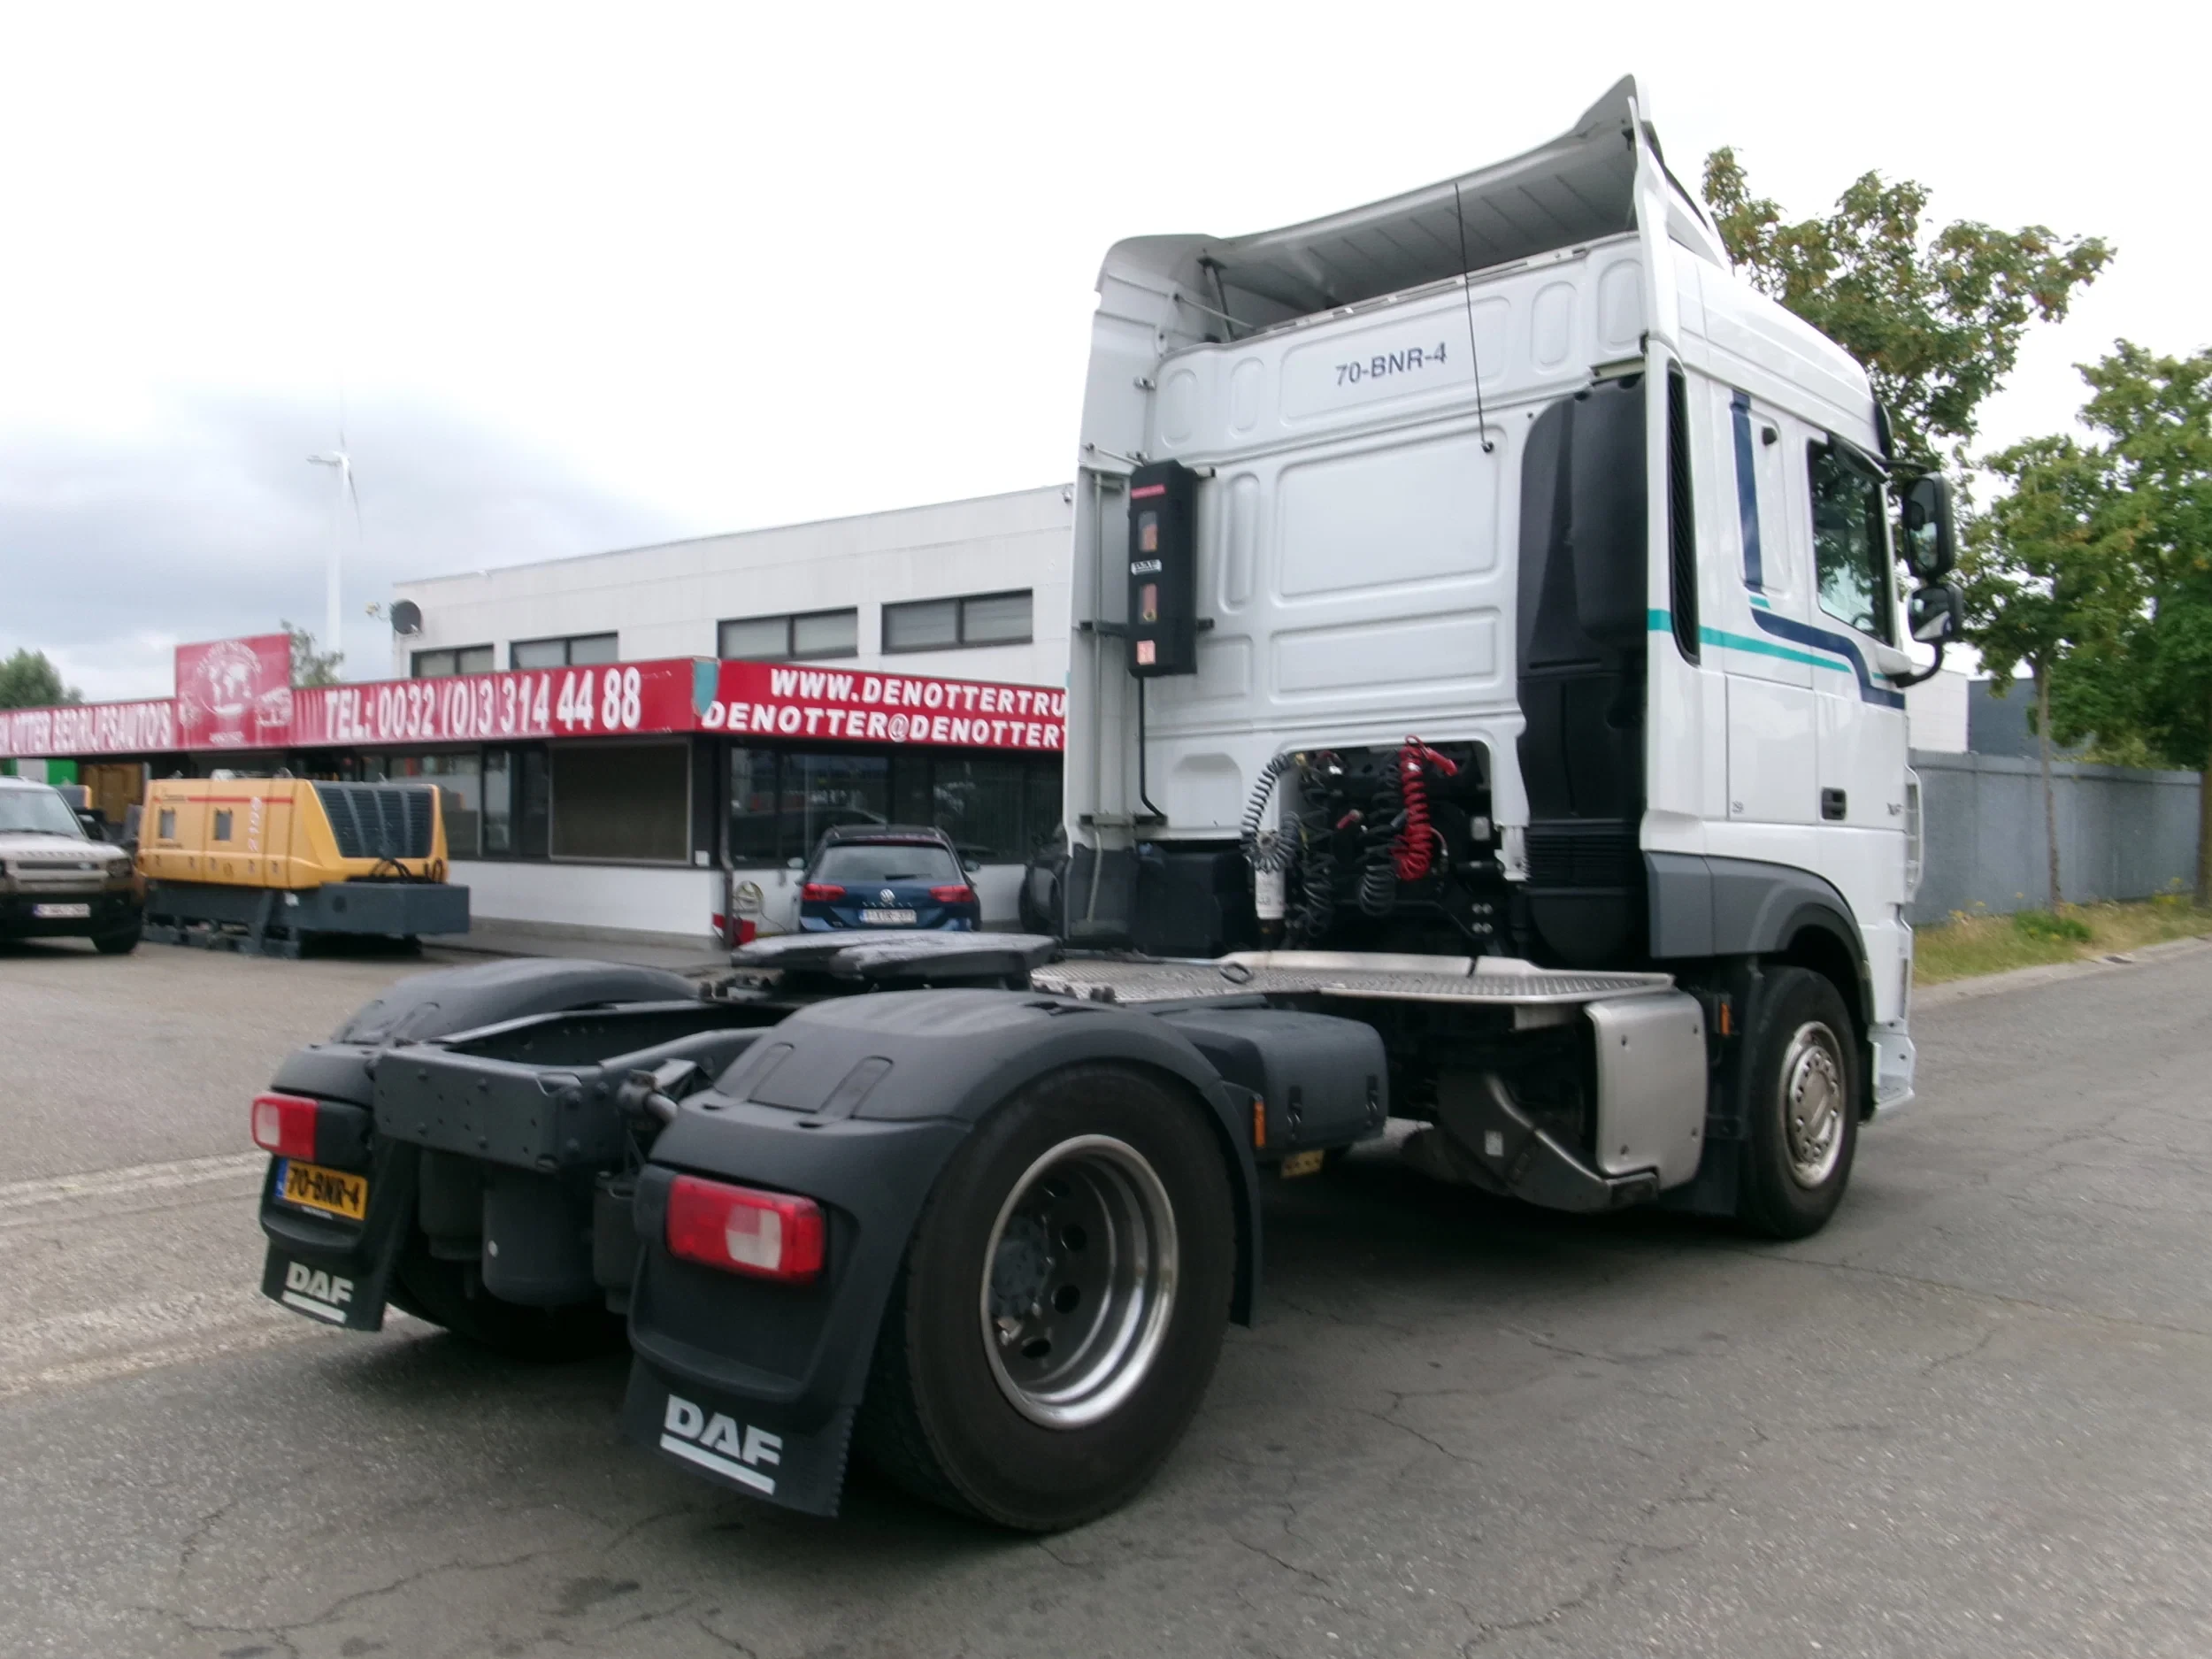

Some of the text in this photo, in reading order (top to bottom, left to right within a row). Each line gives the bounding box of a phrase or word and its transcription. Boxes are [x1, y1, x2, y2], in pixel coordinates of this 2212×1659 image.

[1335, 341, 1448, 387] 70-BNR-4
[324, 688, 373, 741] TEL:
[378, 683, 435, 741] 0032
[500, 673, 550, 733] 314
[557, 670, 595, 731] 44
[602, 666, 641, 730] 88
[701, 700, 1065, 749] DENOTTER@DENOTTER
[286, 1261, 354, 1305] DAF
[664, 1394, 783, 1466] DAF
